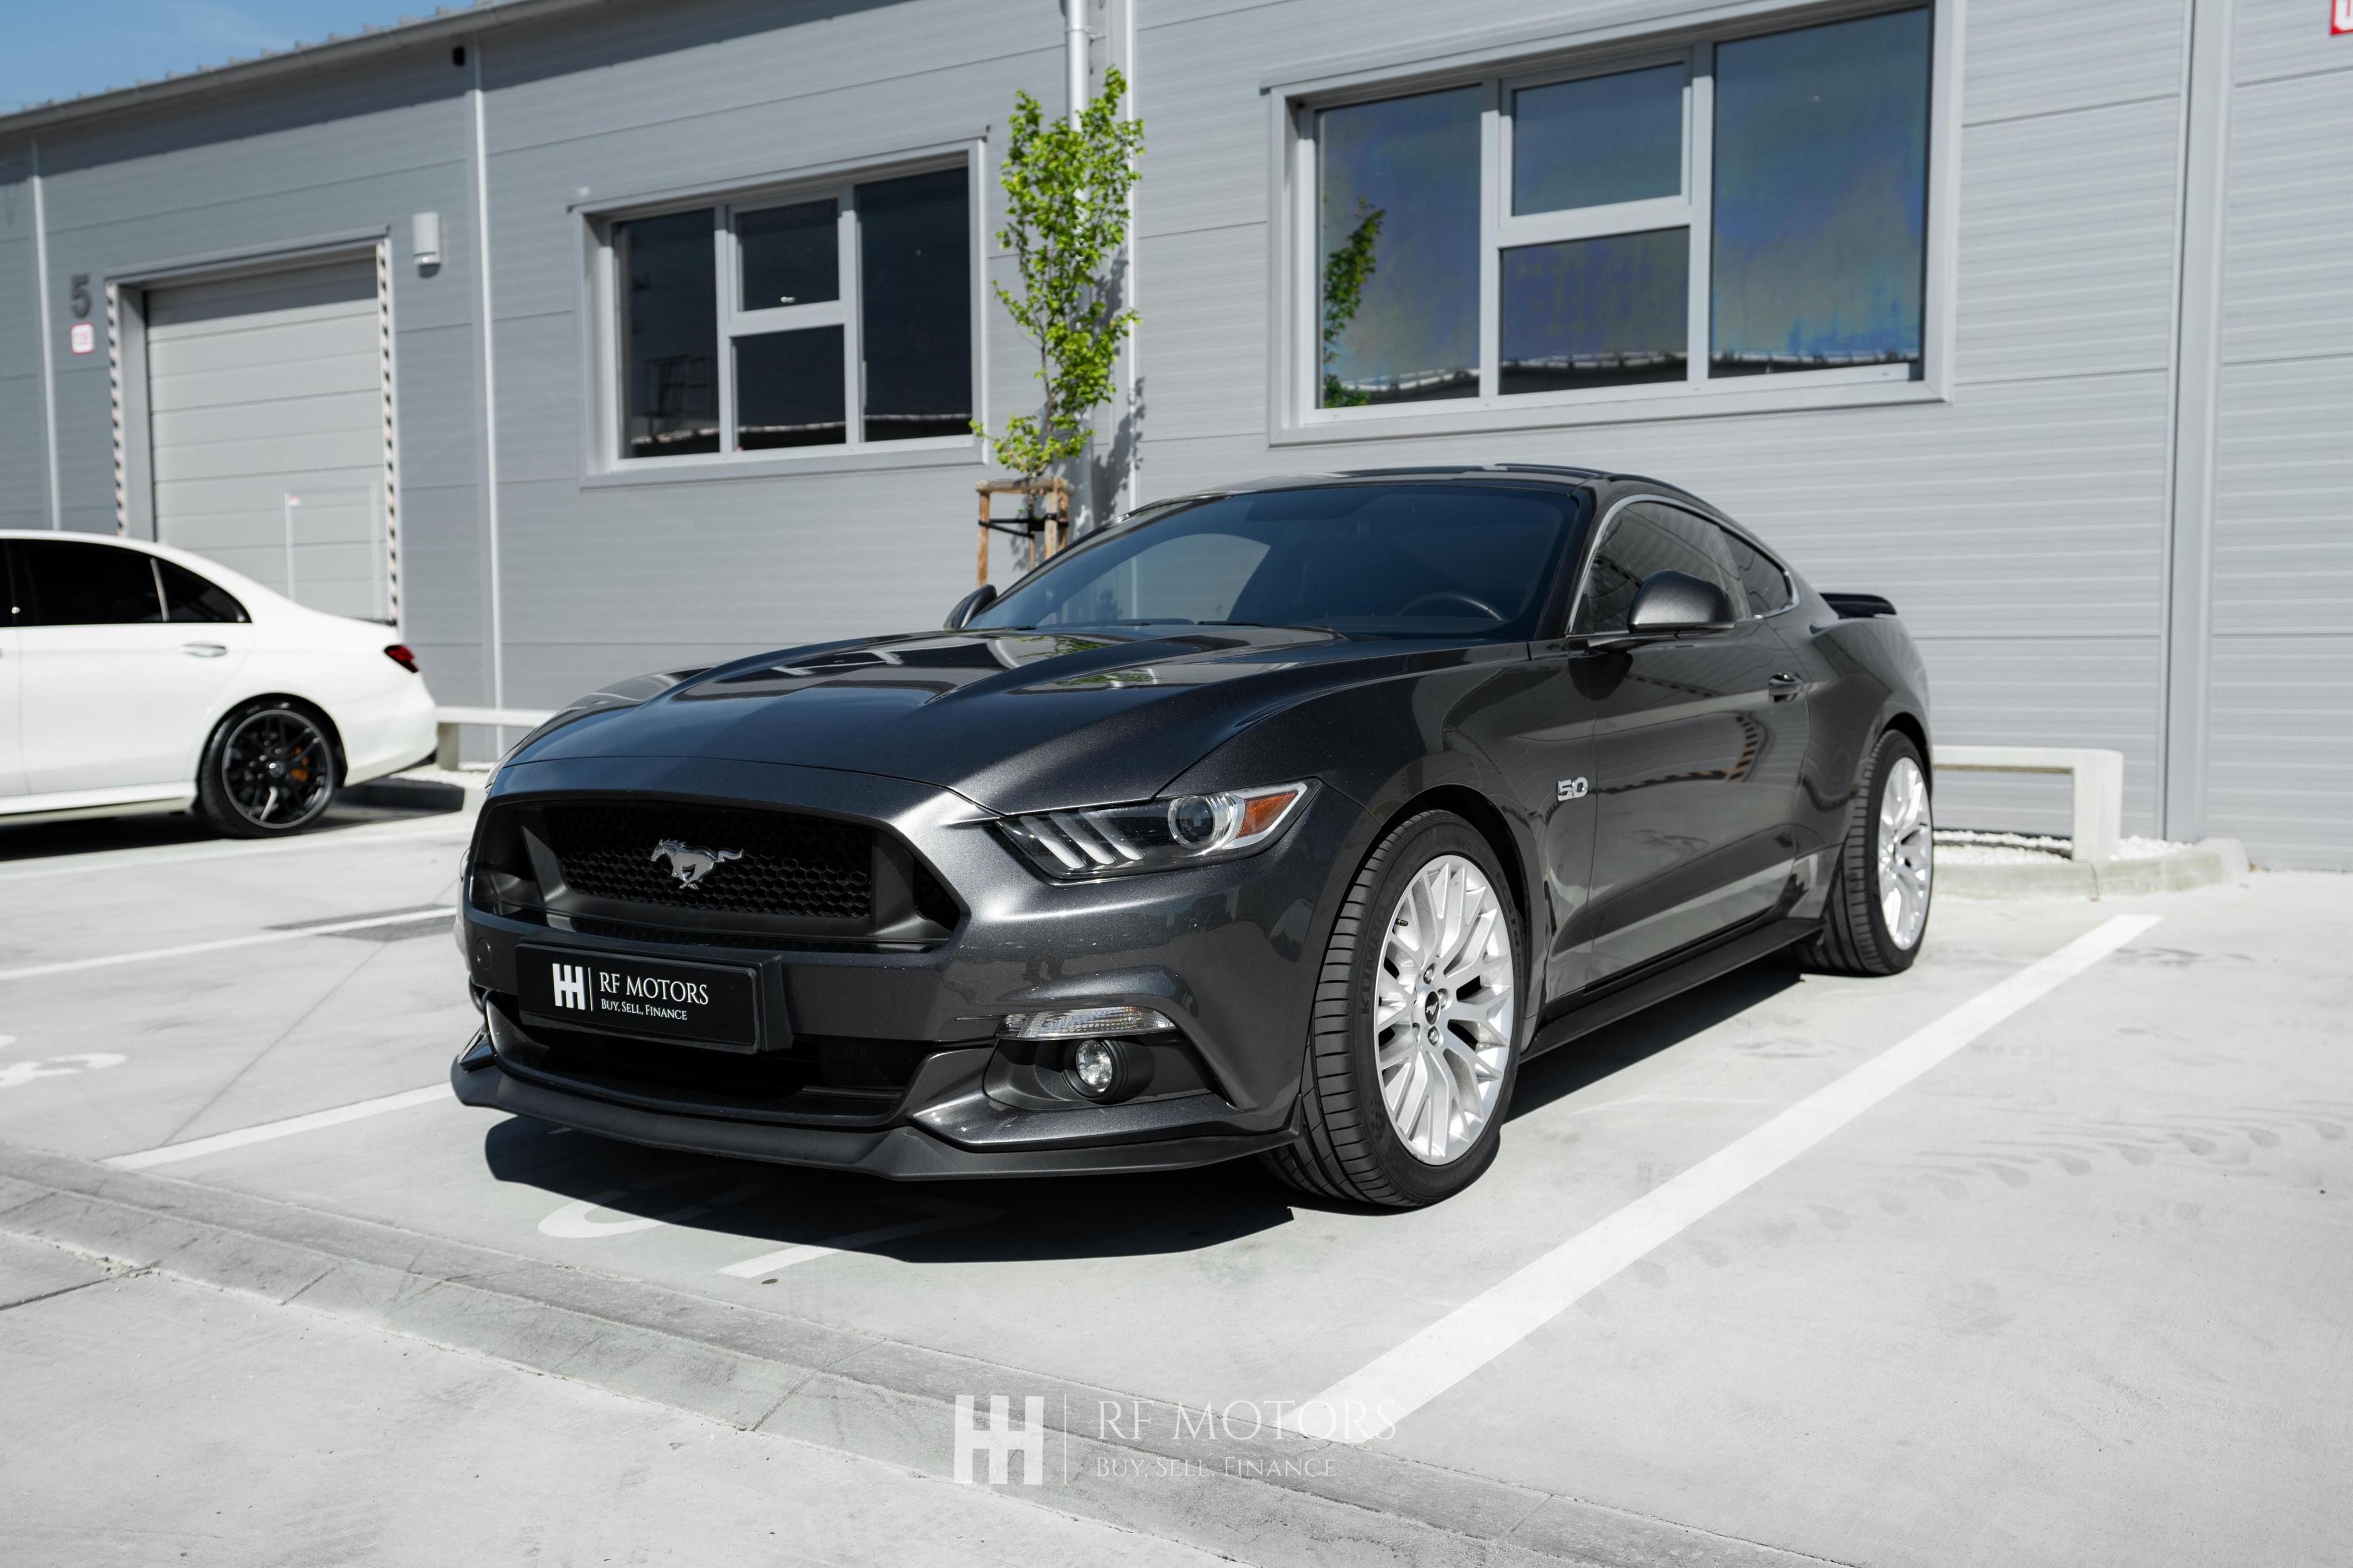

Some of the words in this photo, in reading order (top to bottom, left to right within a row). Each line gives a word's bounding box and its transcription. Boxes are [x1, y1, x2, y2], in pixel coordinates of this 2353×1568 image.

[72, 274, 92, 319] 5
[599, 972, 620, 994] RF
[626, 975, 709, 1005] MOTORS
[601, 998, 620, 1012] BUY,
[622, 1001, 644, 1015] SELL,
[645, 1005, 688, 1020] FINANCE
